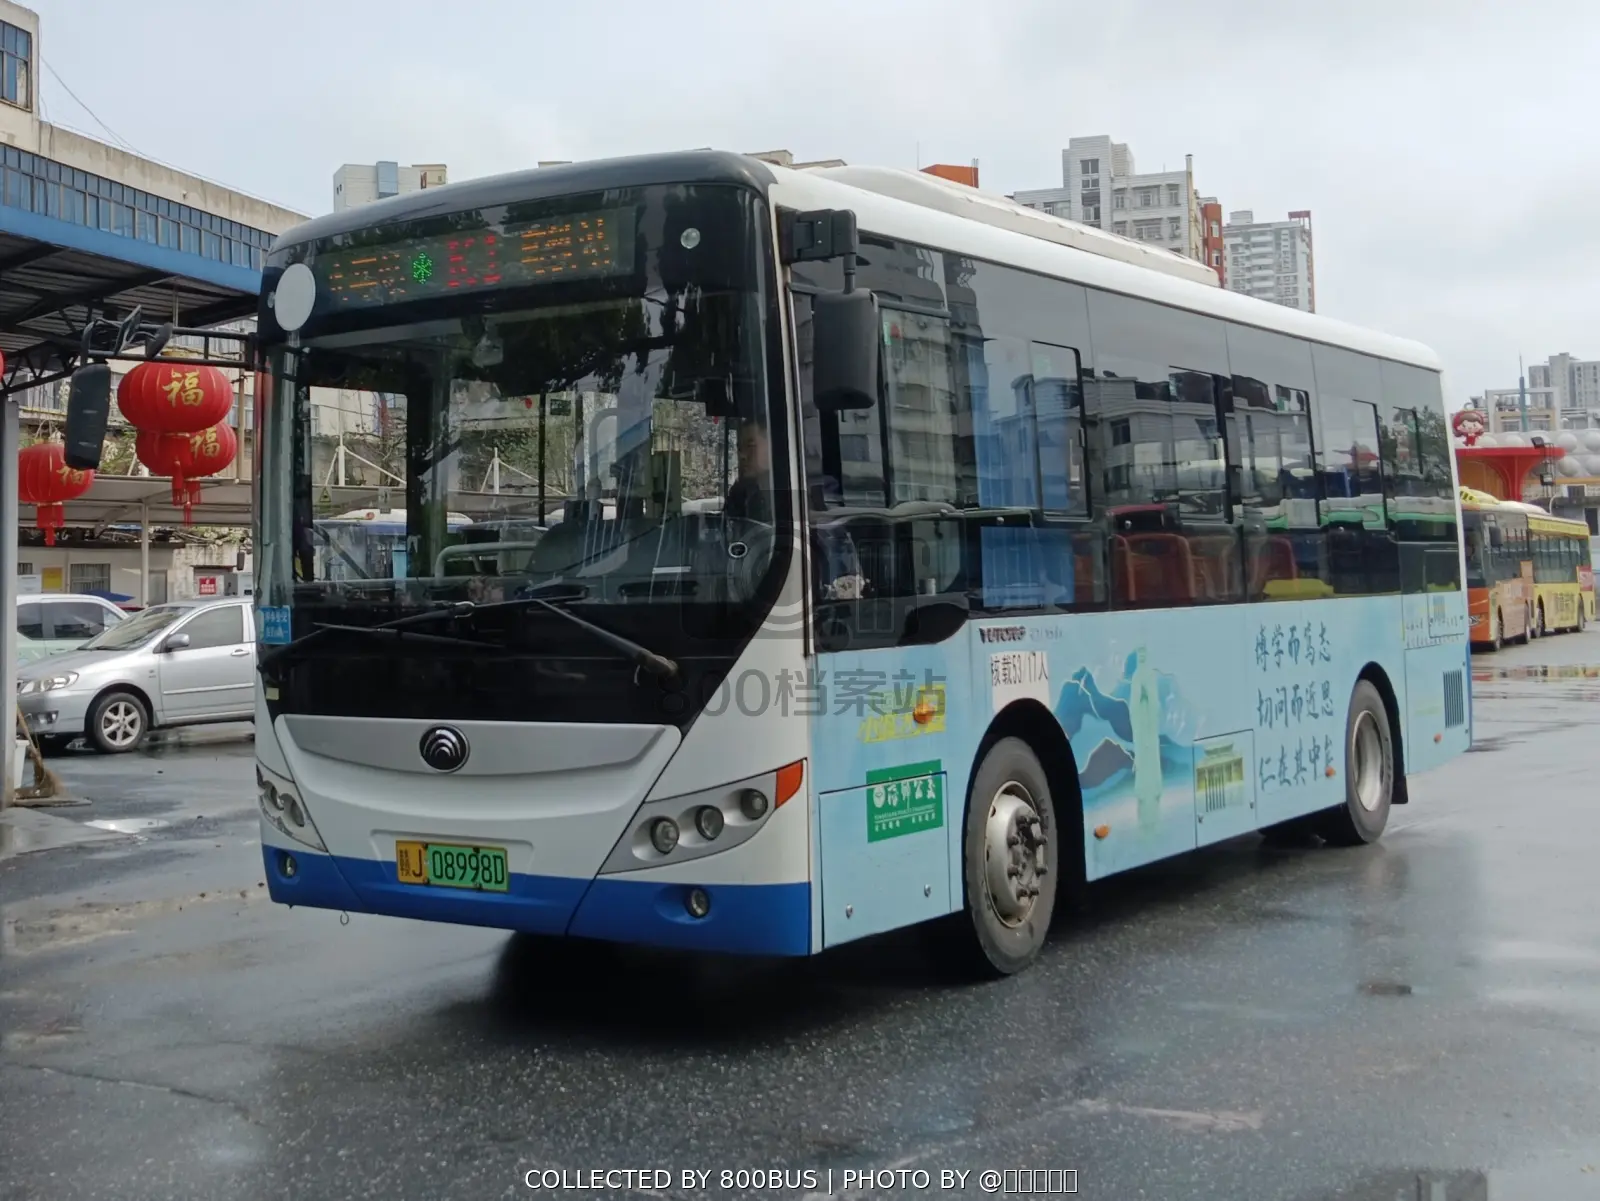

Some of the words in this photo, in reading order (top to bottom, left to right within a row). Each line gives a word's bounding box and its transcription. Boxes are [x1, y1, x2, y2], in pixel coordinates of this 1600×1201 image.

[163, 368, 205, 408] 福
[190, 425, 221, 460] 福
[1256, 680, 1334, 729] 切问而近思
